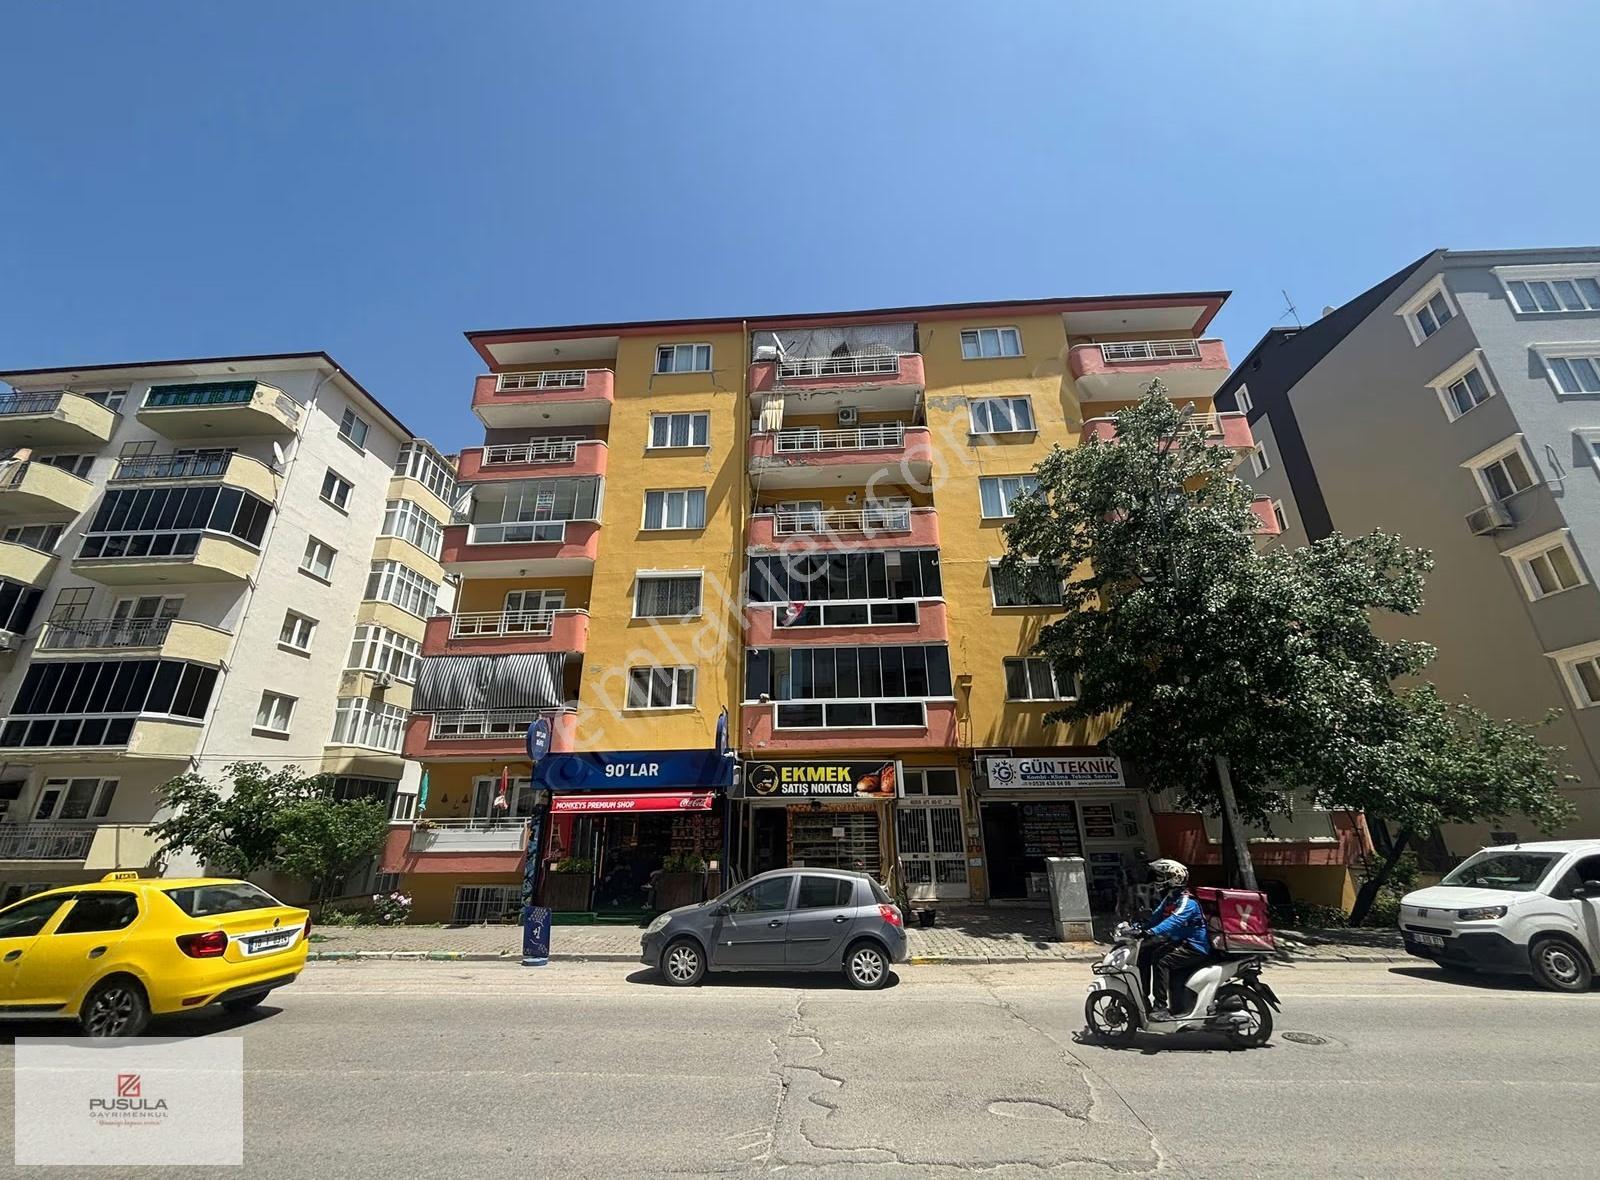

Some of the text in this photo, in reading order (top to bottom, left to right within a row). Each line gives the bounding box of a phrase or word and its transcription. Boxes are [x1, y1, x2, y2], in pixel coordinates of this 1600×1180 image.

[605, 763, 659, 777] 90'LAR
[1019, 758, 1118, 774] GÜN TEKNİK
[781, 766, 852, 782] EKMEK
[781, 783, 852, 796] SATIŞ NOKTASI
[556, 800, 635, 809] MONKEYS PREMIUM SHOP
